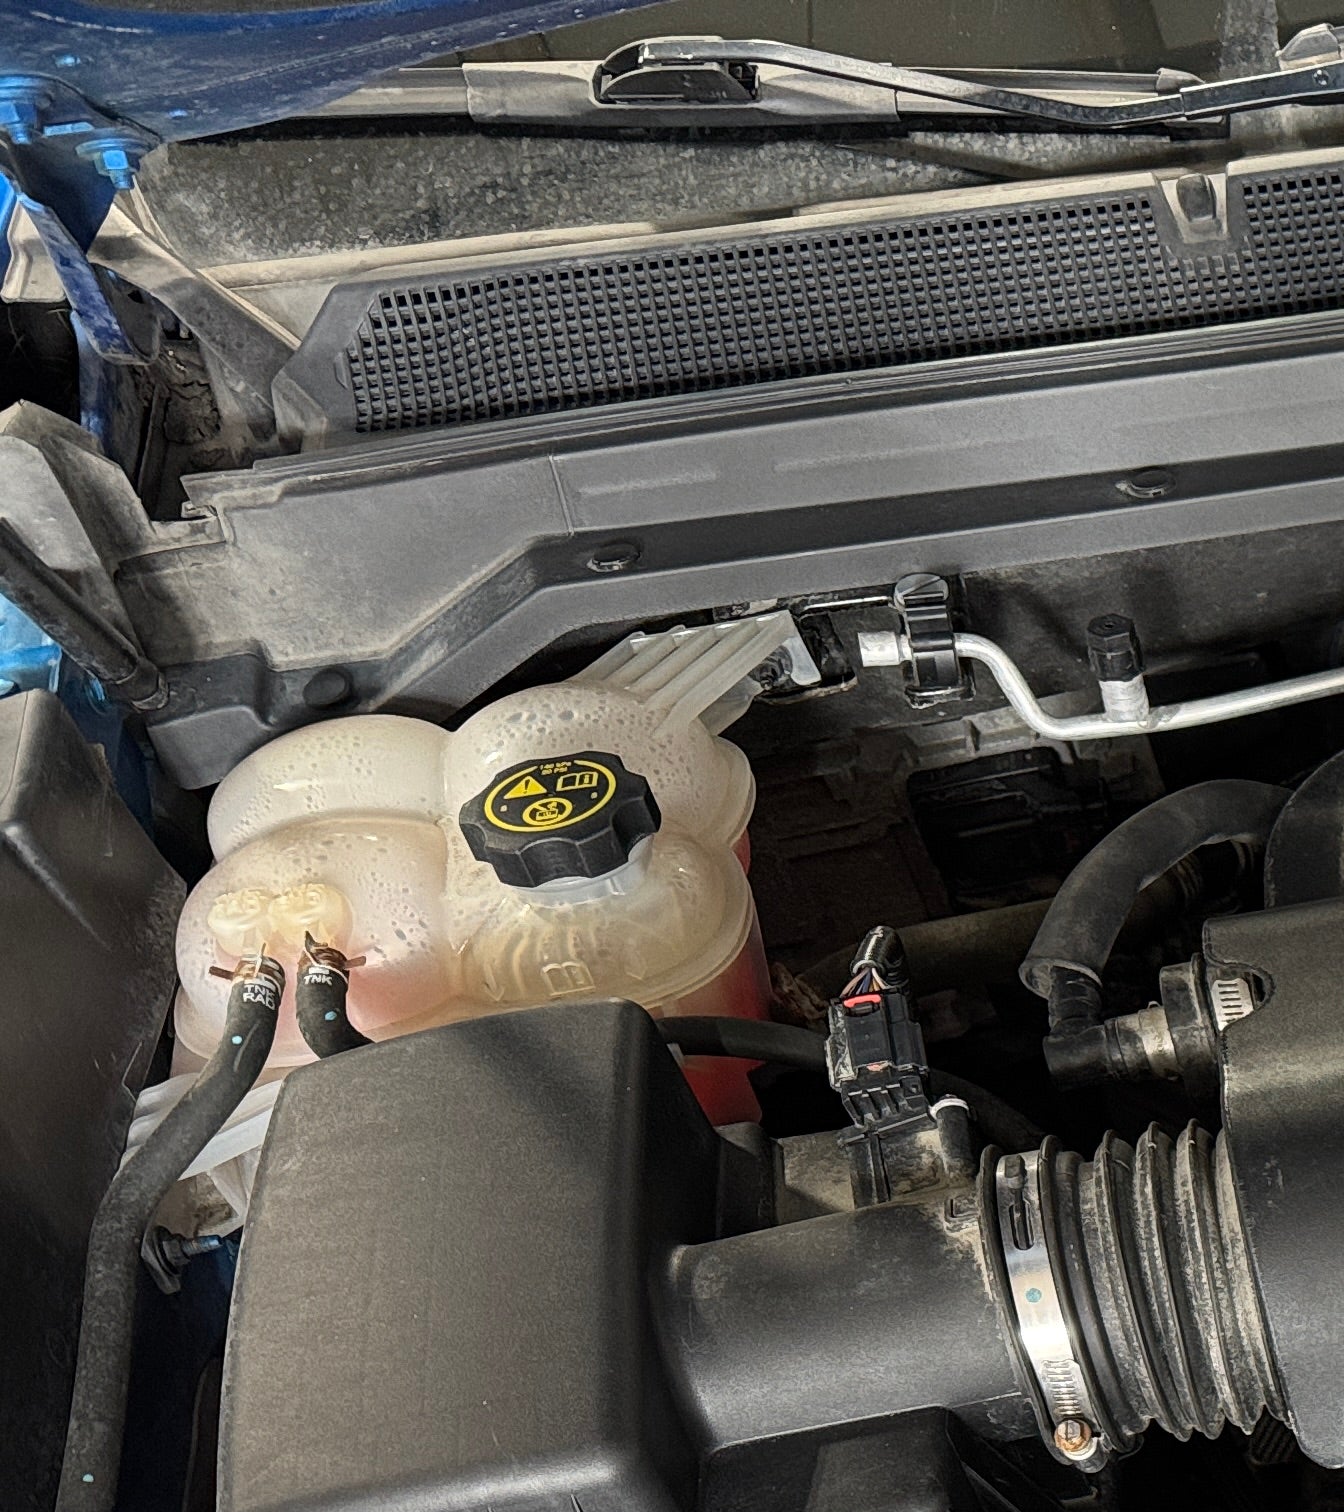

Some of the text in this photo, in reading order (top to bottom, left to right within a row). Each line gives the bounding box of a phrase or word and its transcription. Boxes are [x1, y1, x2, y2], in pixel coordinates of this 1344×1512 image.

[303, 975, 333, 987] TNK
[243, 984, 275, 998] TNK
[242, 992, 276, 1011] RAD
